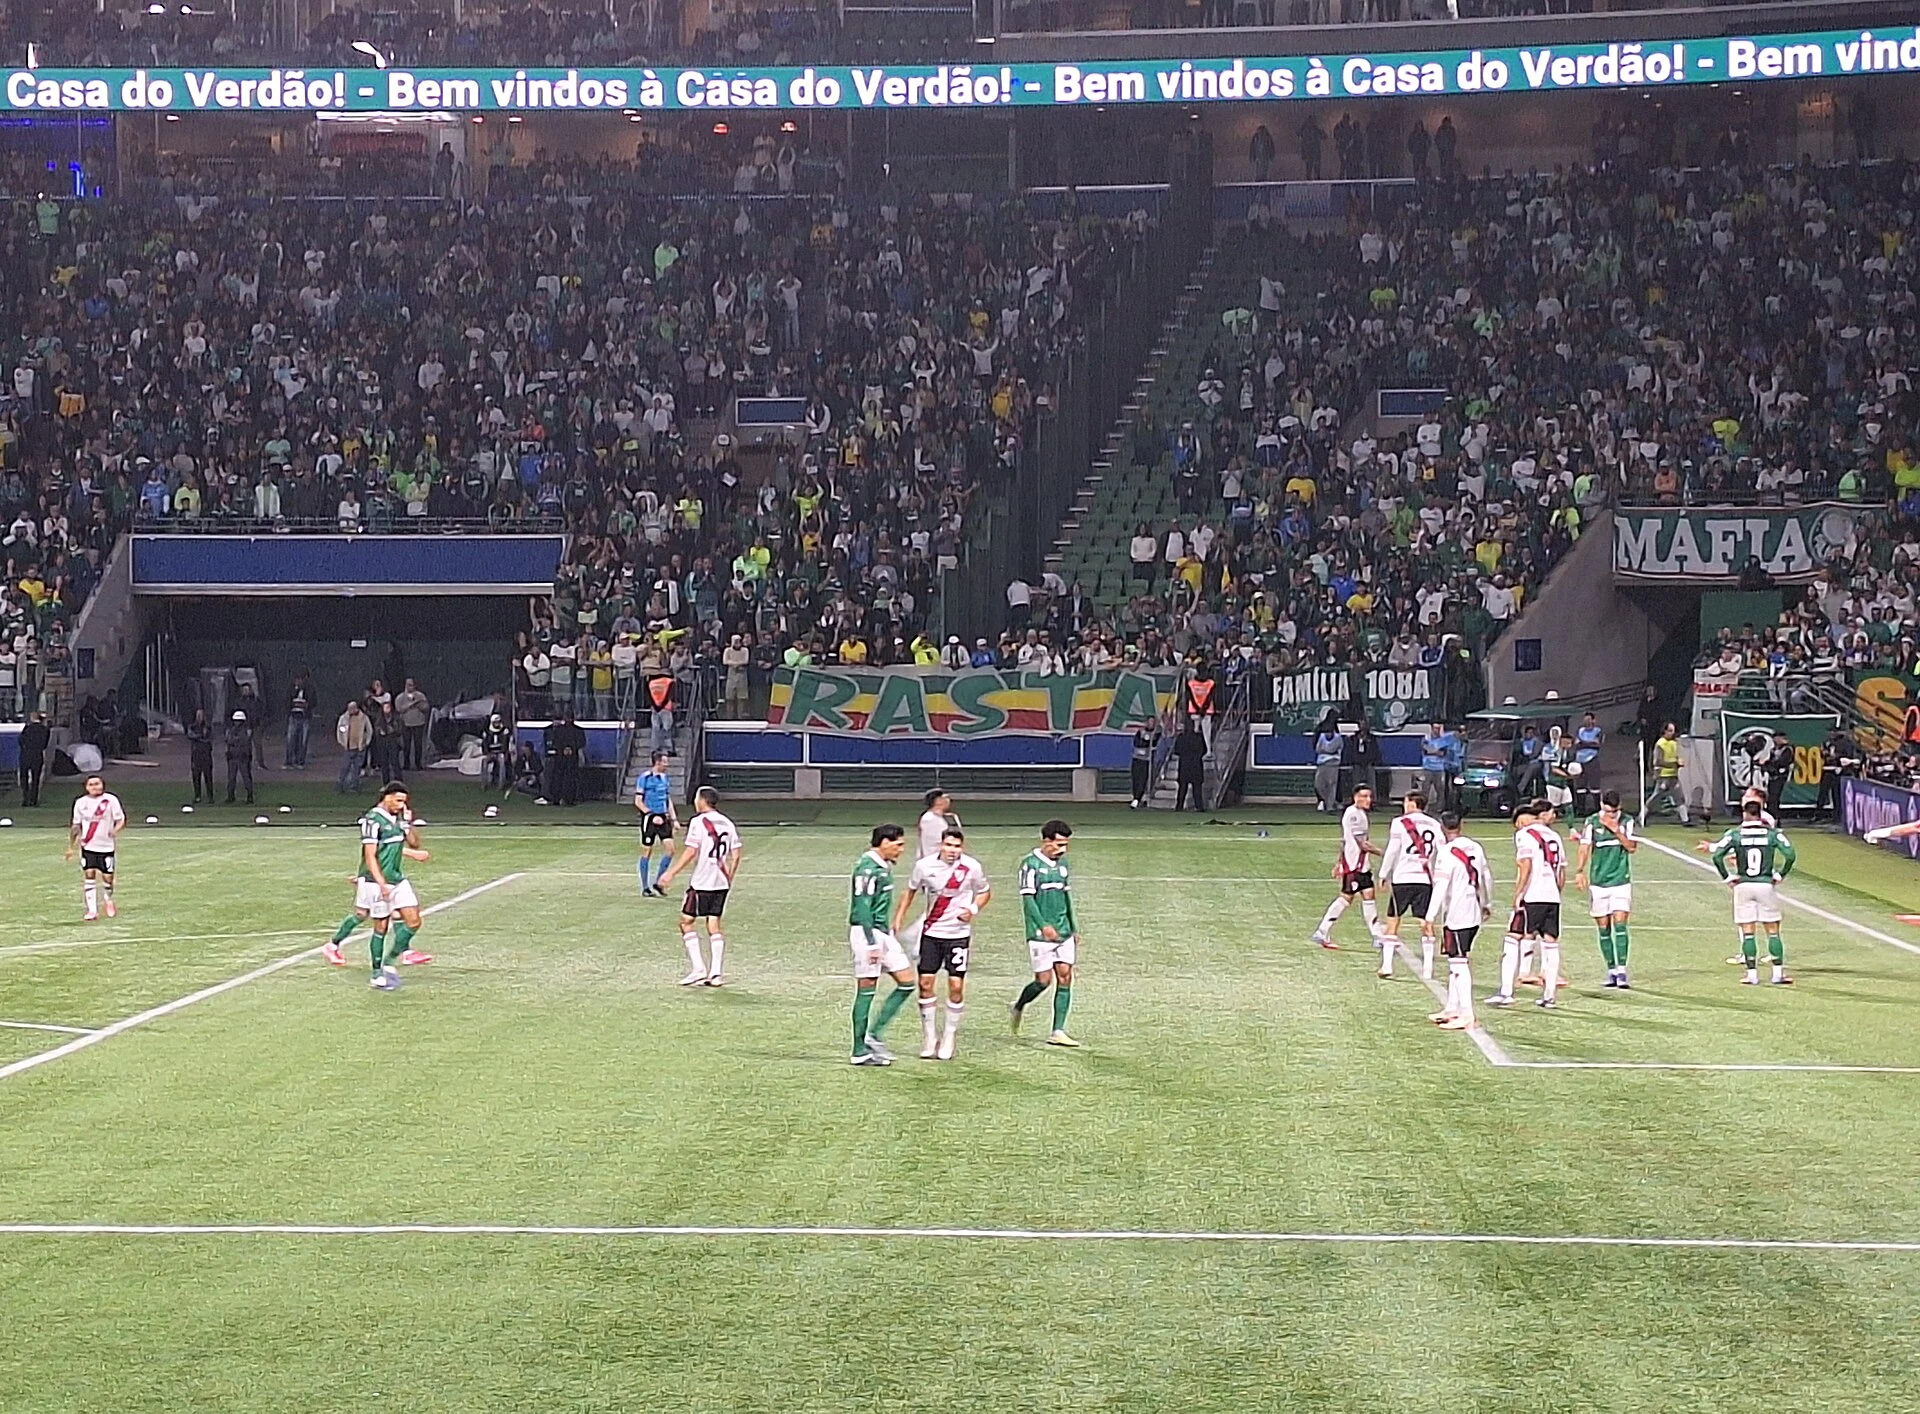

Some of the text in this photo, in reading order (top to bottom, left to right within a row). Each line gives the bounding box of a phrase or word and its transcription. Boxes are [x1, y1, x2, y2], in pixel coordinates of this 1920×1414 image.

[8, 71, 109, 108] Casa
[122, 69, 172, 108] do
[184, 69, 346, 108] Verdão!
[388, 71, 478, 108] Bem
[491, 69, 627, 107] vindos
[640, 70, 663, 107] à
[677, 72, 777, 107] Casa
[790, 68, 840, 106] do
[852, 66, 1011, 105] Verdão!
[1055, 66, 1144, 103] Bem
[1157, 60, 1293, 99] vindos
[1306, 58, 1330, 96] à
[1343, 57, 1444, 95] Casa
[1457, 51, 1507, 91] do
[1520, 44, 1683, 88] Verdão!
[1729, 39, 1821, 77] Bem
[1614, 516, 1813, 575] MAFIA
[784, 666, 1160, 735] RASTA
[1273, 666, 1350, 706] FAMÍLIA
[707, 831, 729, 859] 26
[1746, 848, 1762, 876] 9
